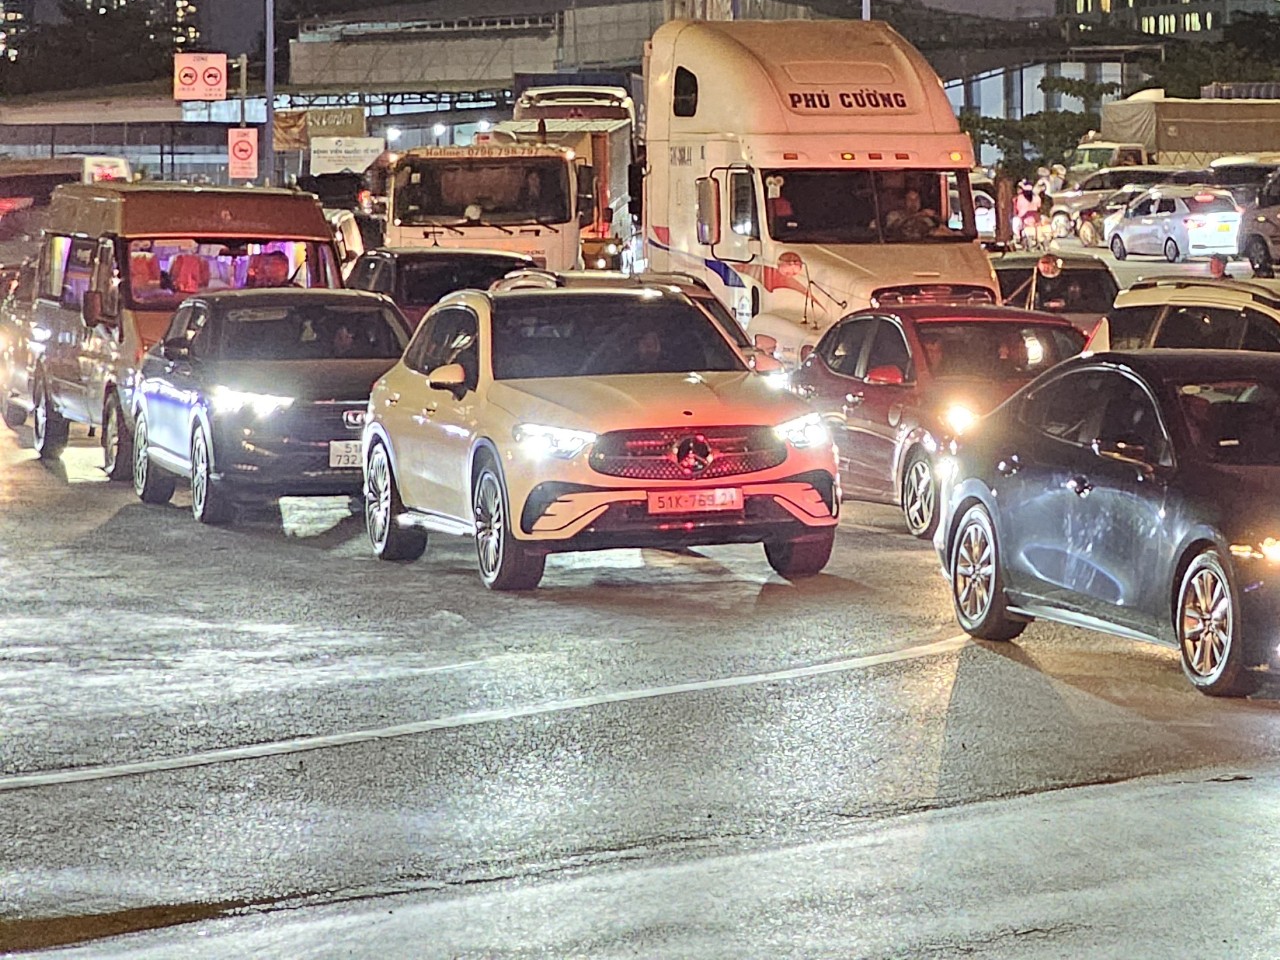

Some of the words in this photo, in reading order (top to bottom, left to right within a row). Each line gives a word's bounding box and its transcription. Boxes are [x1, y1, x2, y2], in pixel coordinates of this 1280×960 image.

[838, 88, 907, 109] CƯỜNG
[344, 443, 363, 454] 51
[336, 455, 363, 465] 732
